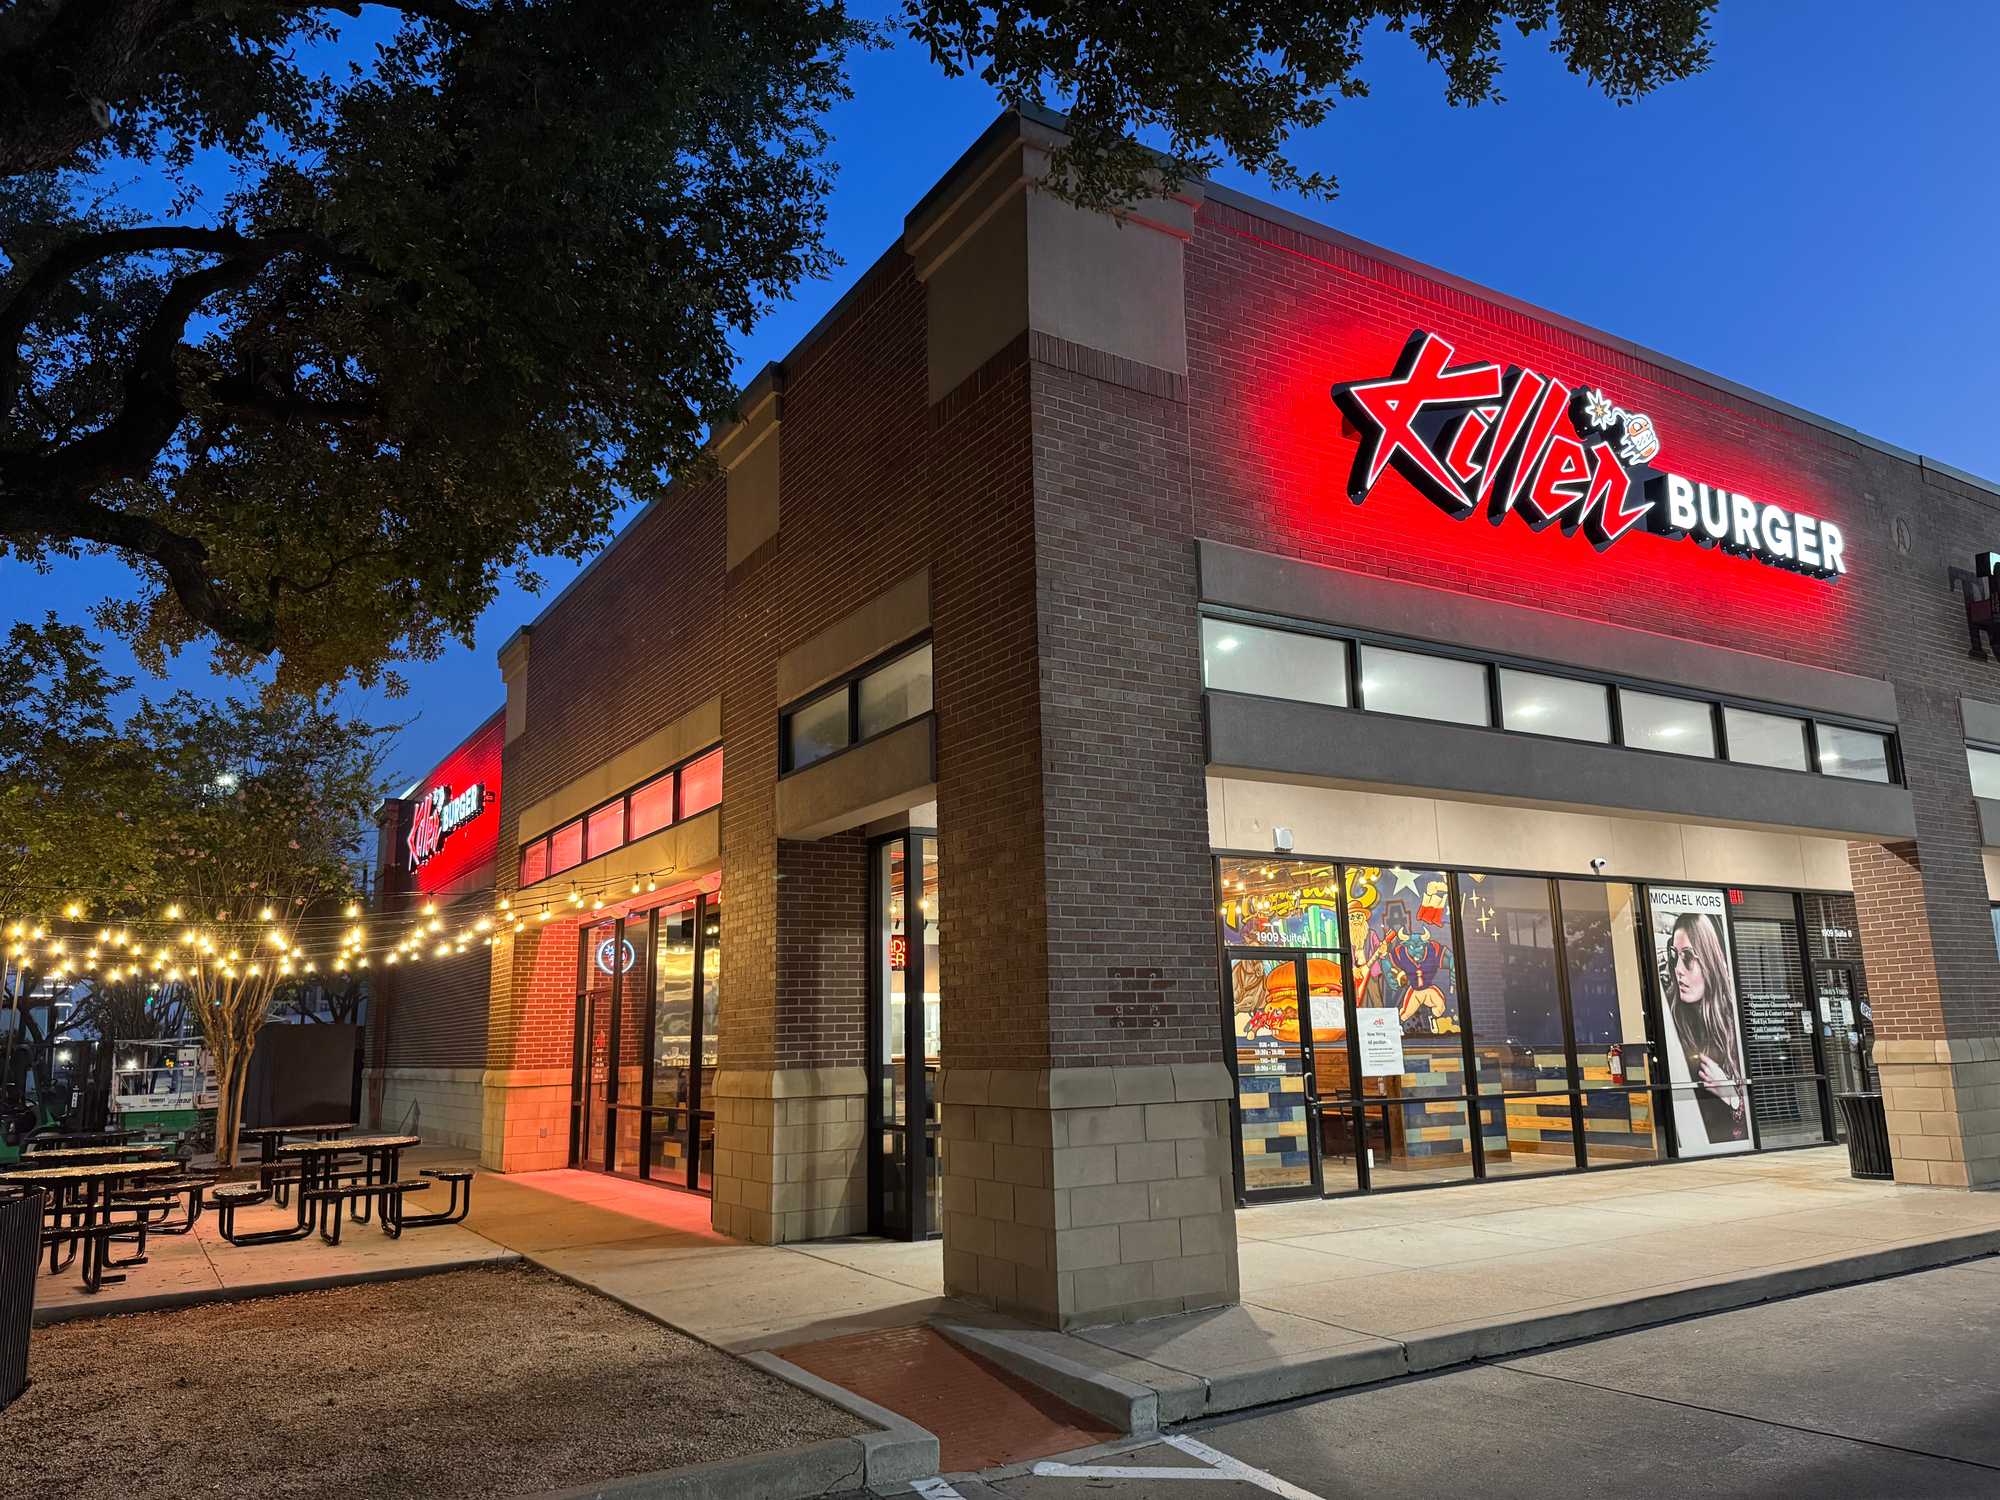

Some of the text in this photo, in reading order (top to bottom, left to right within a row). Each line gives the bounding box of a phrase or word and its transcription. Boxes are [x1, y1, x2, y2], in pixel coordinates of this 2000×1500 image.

[1346, 331, 1847, 574] Killen BURGER
[442, 784, 478, 832] BURGER
[1649, 892, 1693, 906] MICHAEL
[1695, 895, 1721, 907] KORS
[1256, 931, 1279, 942] 1909
